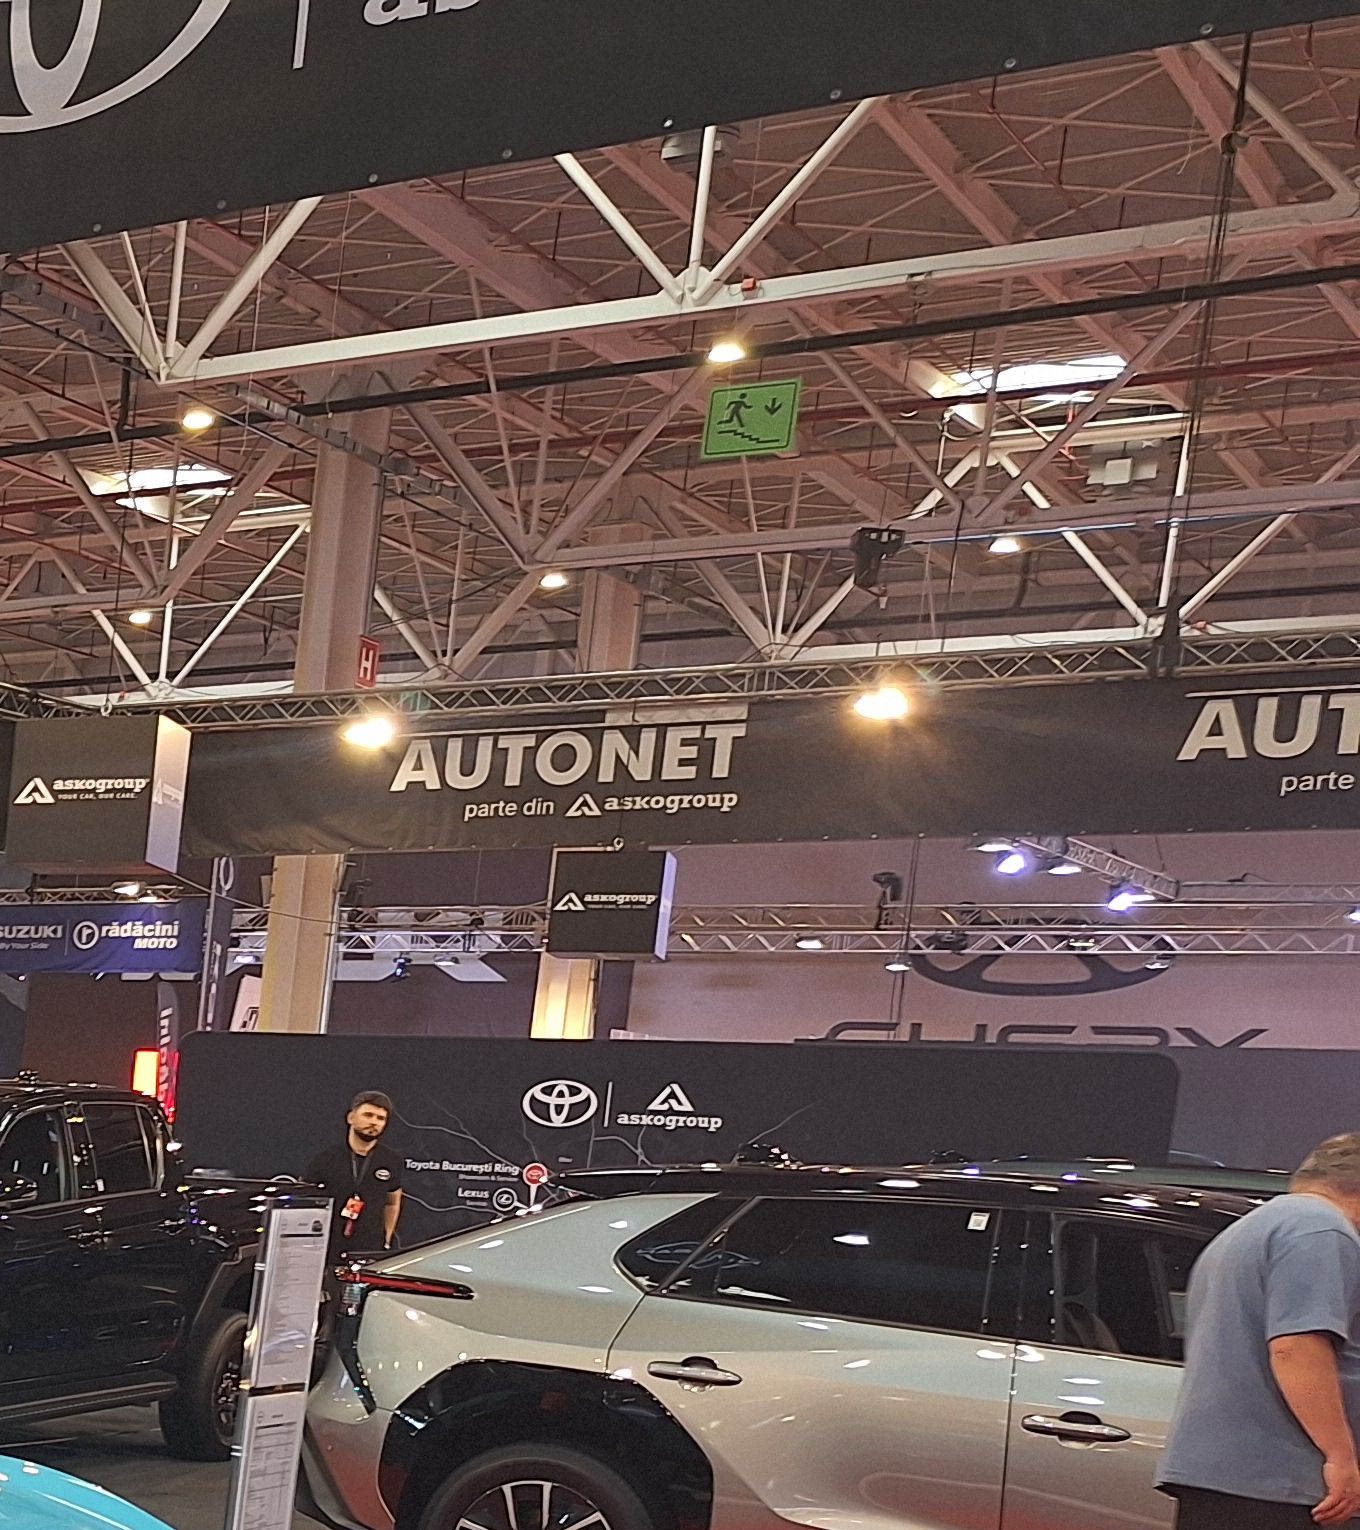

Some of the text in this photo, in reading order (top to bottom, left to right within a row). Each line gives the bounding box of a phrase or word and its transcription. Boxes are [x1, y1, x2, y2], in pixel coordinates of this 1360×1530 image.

[1177, 690, 1360, 761] AUT
[389, 723, 747, 792] AUTONET
[53, 777, 148, 793] askogroup
[1279, 769, 1355, 797] parte
[464, 792, 738, 821] parte din askogroup
[101, 920, 179, 937] rădăcini
[132, 937, 179, 950] MOTO
[617, 1111, 723, 1132] askogroup
[405, 1158, 440, 1173] Toyota
[494, 1163, 521, 1177] Ring
[457, 1187, 490, 1199] Lexus
